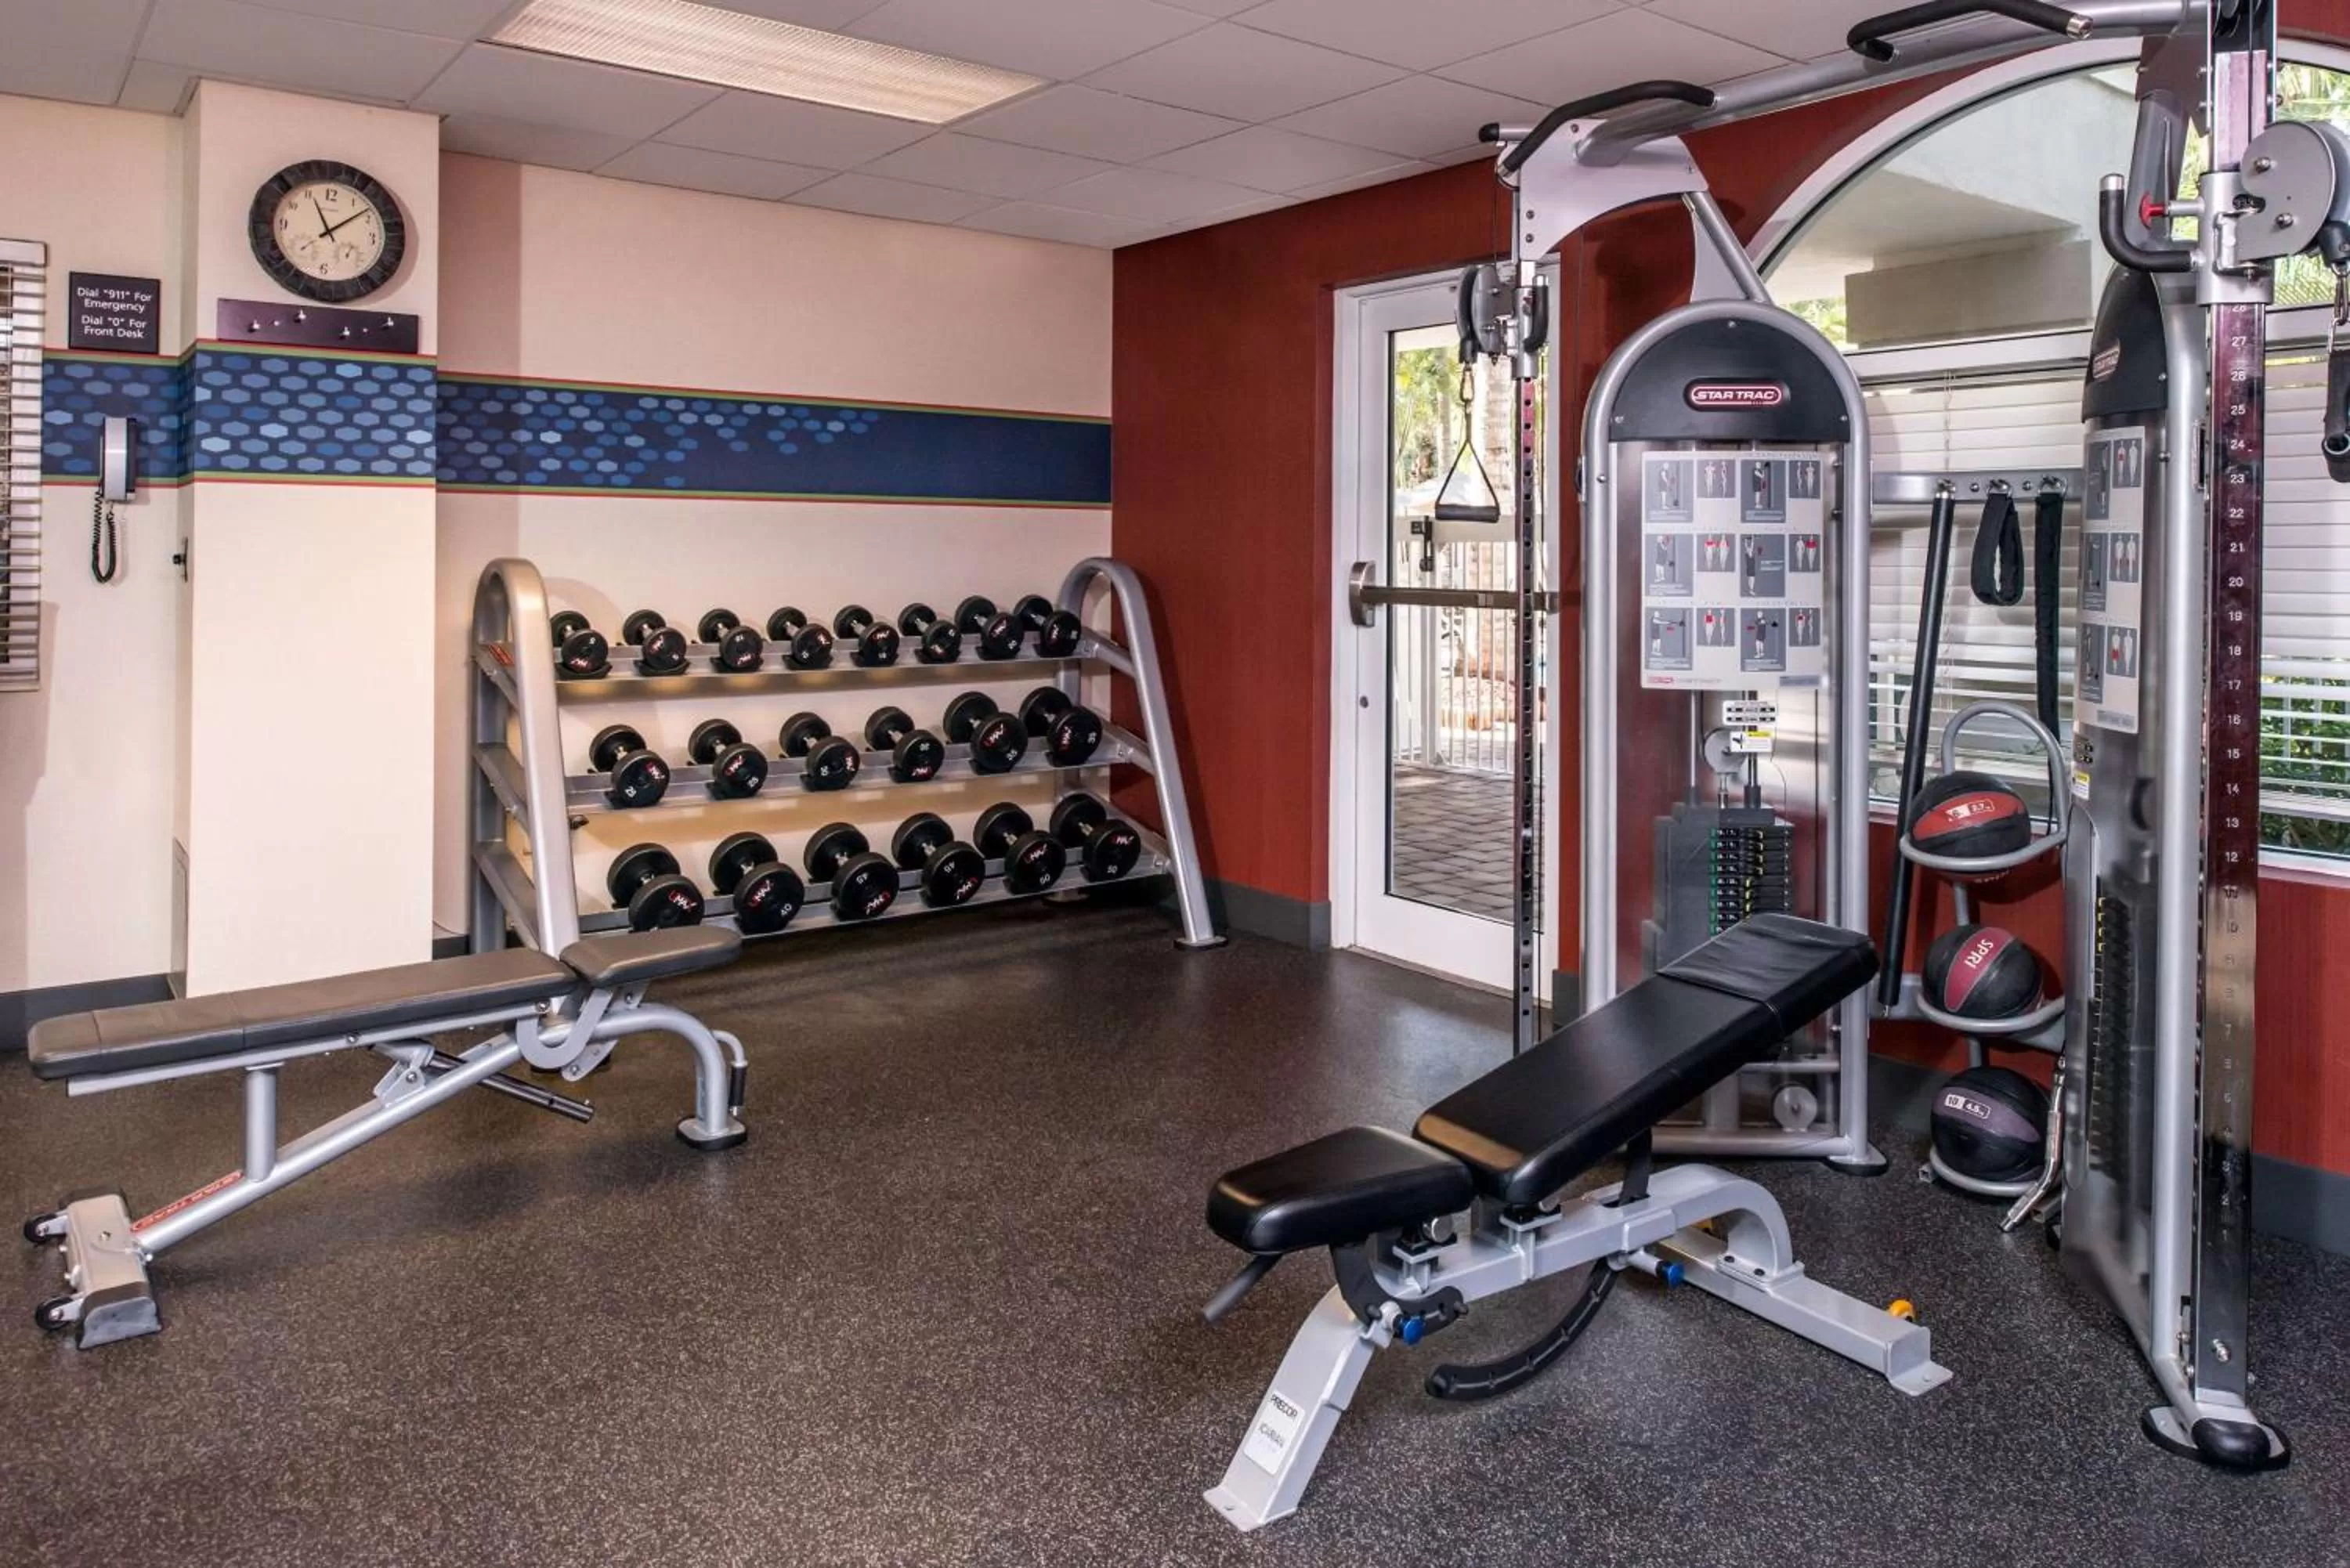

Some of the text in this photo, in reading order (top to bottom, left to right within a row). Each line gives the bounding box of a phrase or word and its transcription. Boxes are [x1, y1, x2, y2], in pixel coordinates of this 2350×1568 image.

[325, 188, 338, 201] 12
[279, 215, 288, 230] 9
[369, 233, 376, 245] 3
[77, 287, 152, 302] Dial "911" For
[84, 298, 145, 313] Emergency
[81, 314, 147, 328] Dial "0" For
[84, 325, 145, 338] Front Desk
[2231, 336, 2247, 347] 27
[1694, 391, 1775, 400] STAR TRAC
[2230, 404, 2246, 415] 25
[2230, 439, 2245, 450] 24
[2230, 474, 2245, 484] 23
[2229, 508, 2244, 518] 22
[2229, 543, 2244, 552] 21
[2228, 577, 2243, 587] 20
[2228, 646, 2242, 656] 18
[2227, 681, 2241, 690] 17
[2227, 714, 2241, 724] 16
[2227, 749, 2240, 759] 15
[2226, 784, 2240, 796] 14
[2225, 818, 2240, 828] 13
[2225, 851, 2239, 862] 12
[1964, 939, 1994, 969] SPRI
